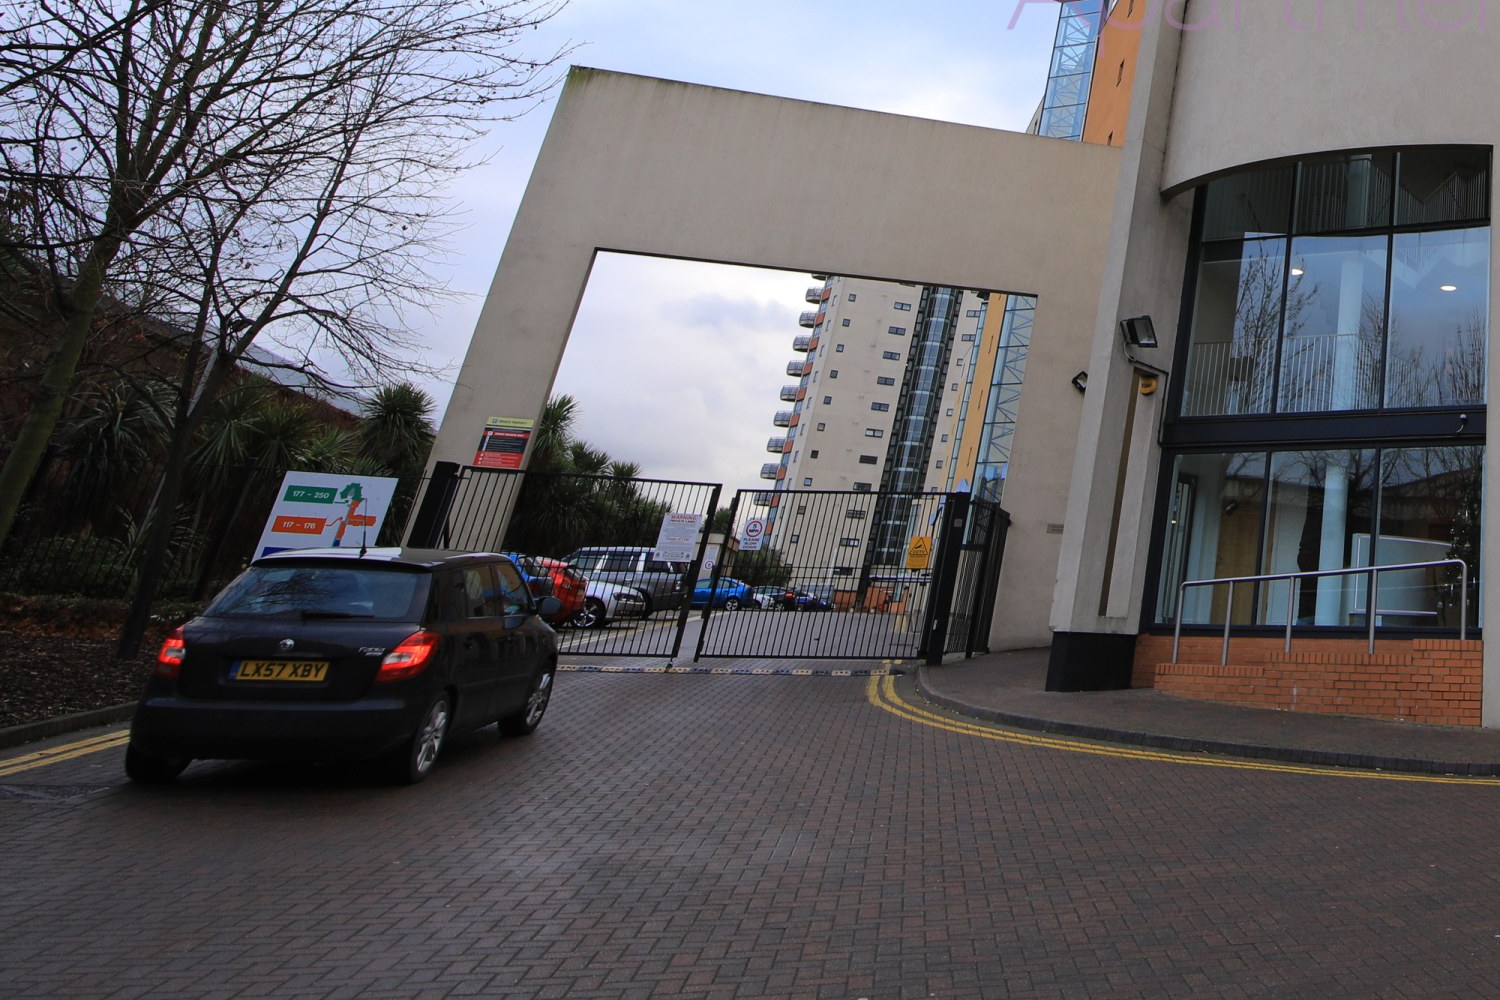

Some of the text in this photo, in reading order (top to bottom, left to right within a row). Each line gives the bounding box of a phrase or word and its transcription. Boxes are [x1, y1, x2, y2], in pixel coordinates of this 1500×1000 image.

[314, 491, 329, 499] 250
[240, 662, 325, 678] LX57 XBY
